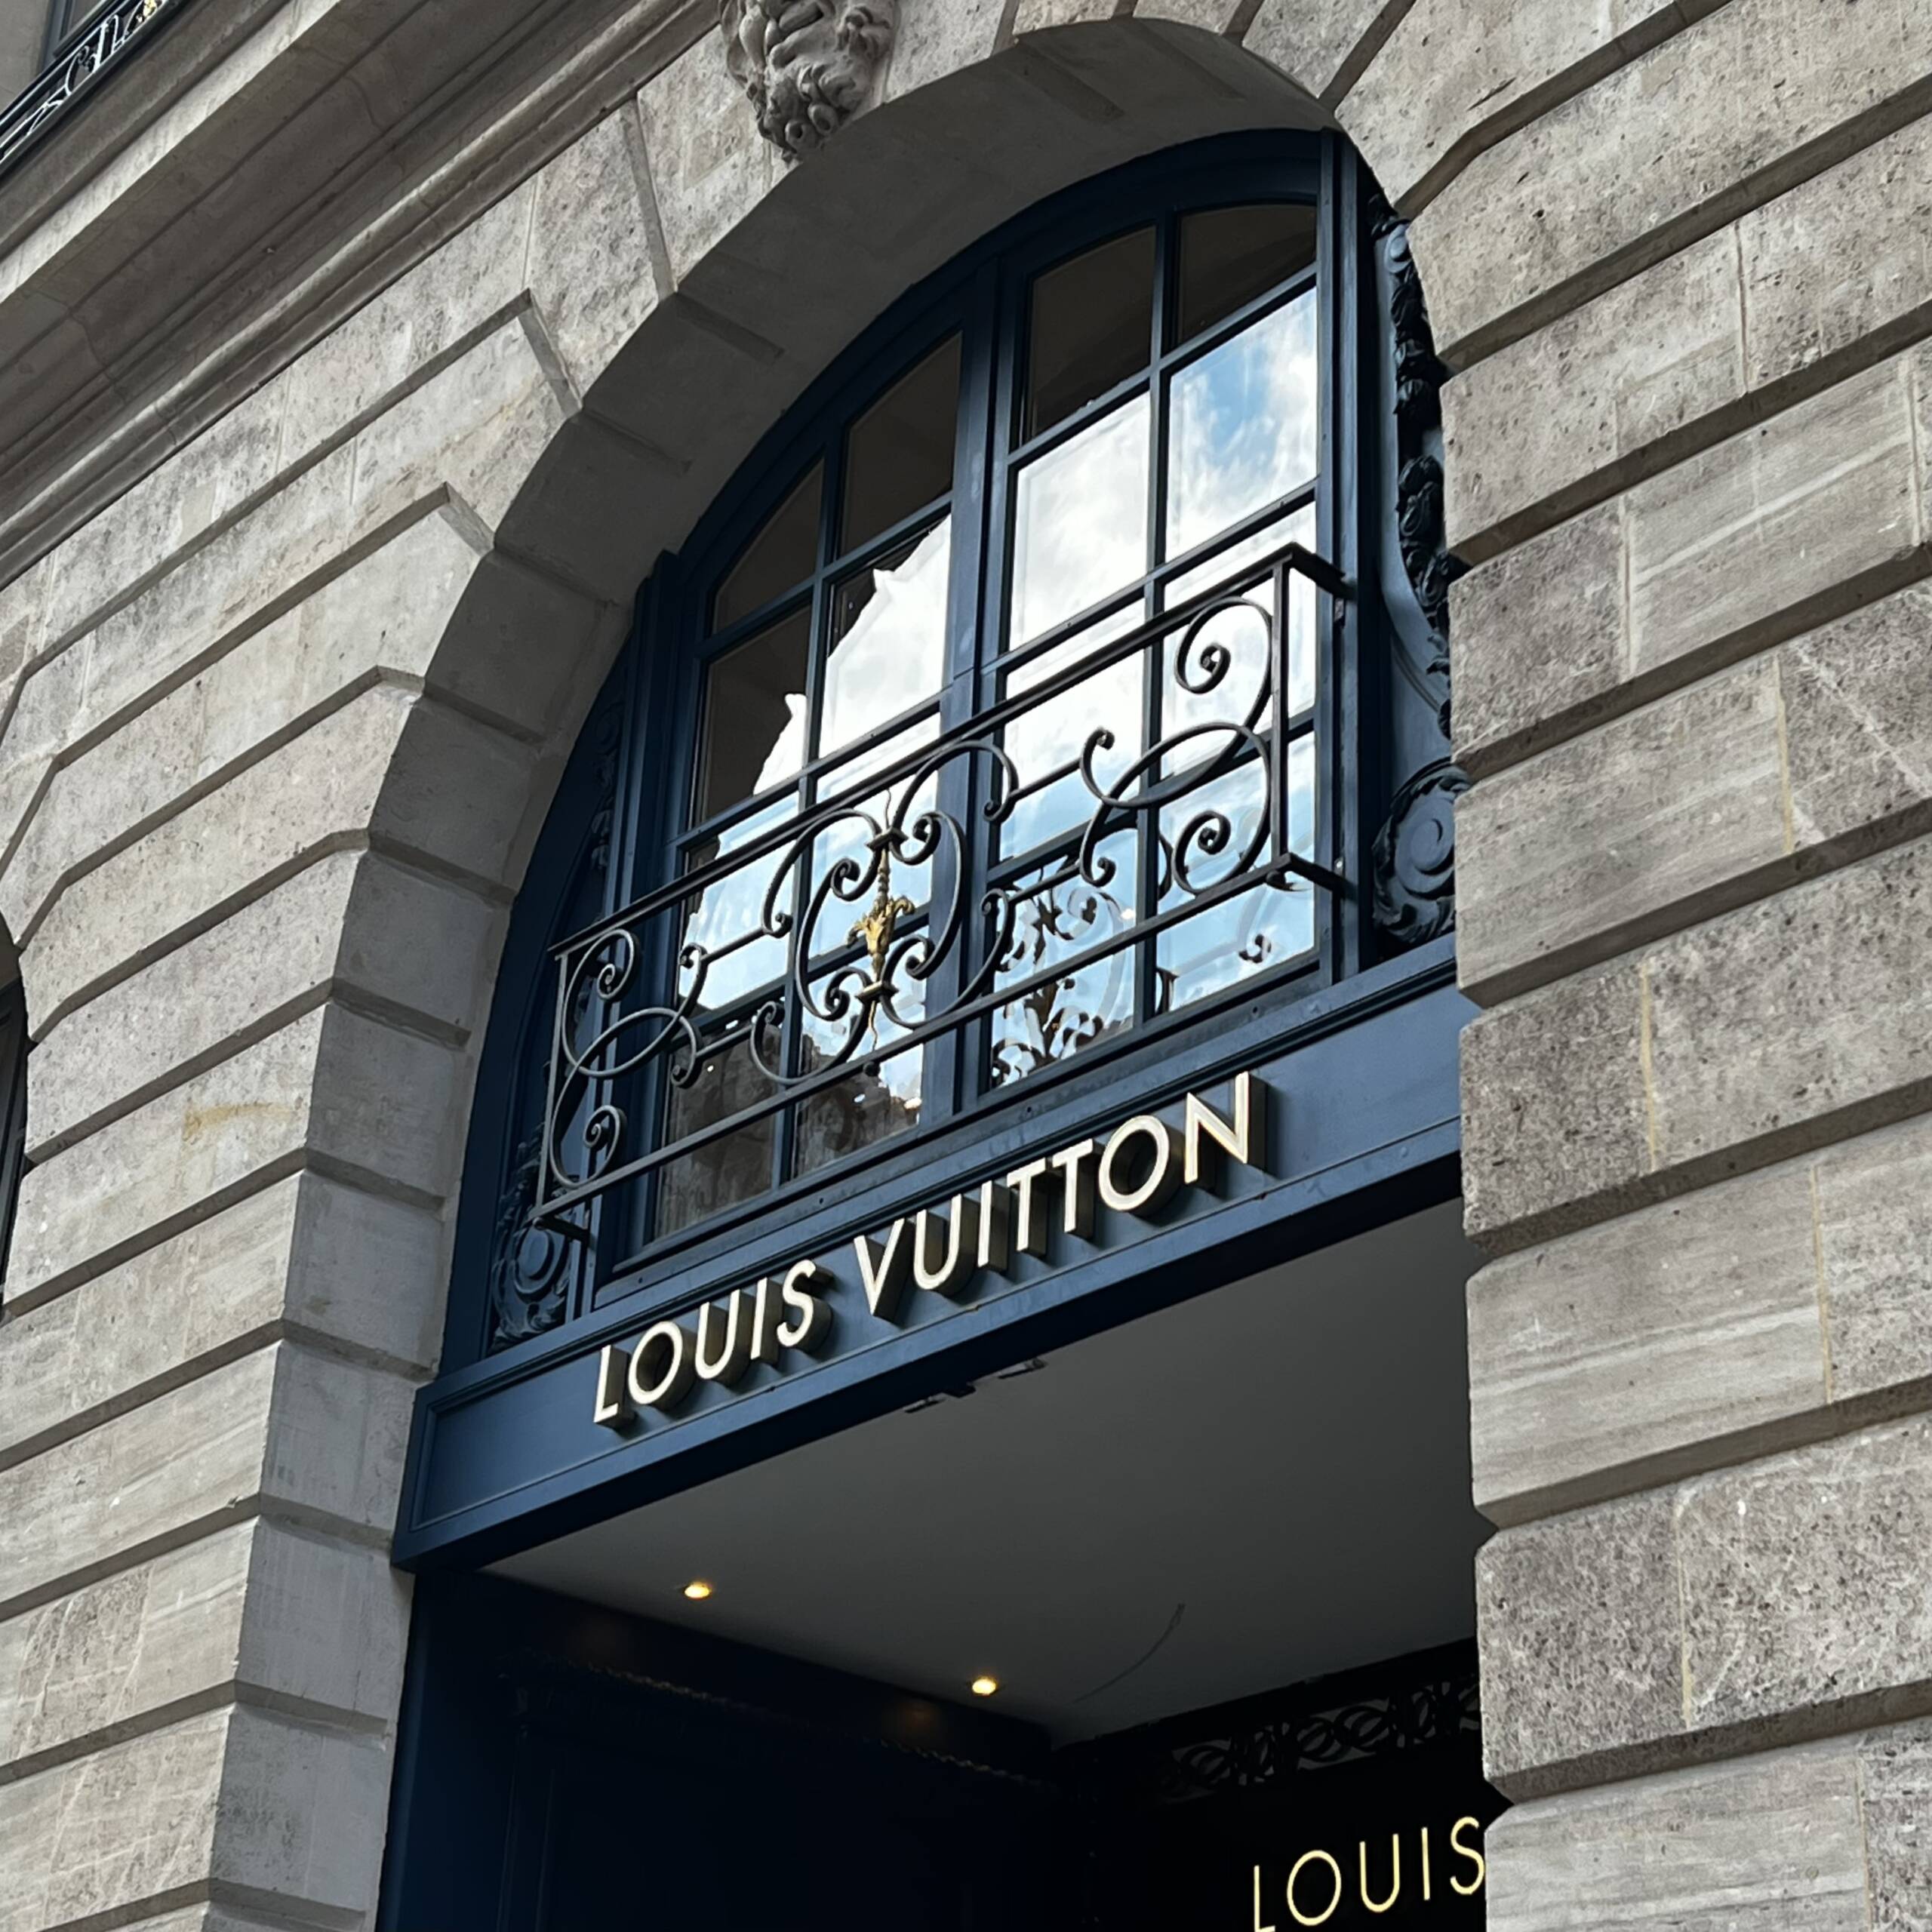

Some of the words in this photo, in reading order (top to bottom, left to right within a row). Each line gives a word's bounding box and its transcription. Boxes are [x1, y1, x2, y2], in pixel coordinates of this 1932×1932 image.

[593, 1258, 826, 1428] LOUIS
[854, 1070, 1257, 1319] VUITTON
[1254, 1816, 1485, 1932] LOUIS
